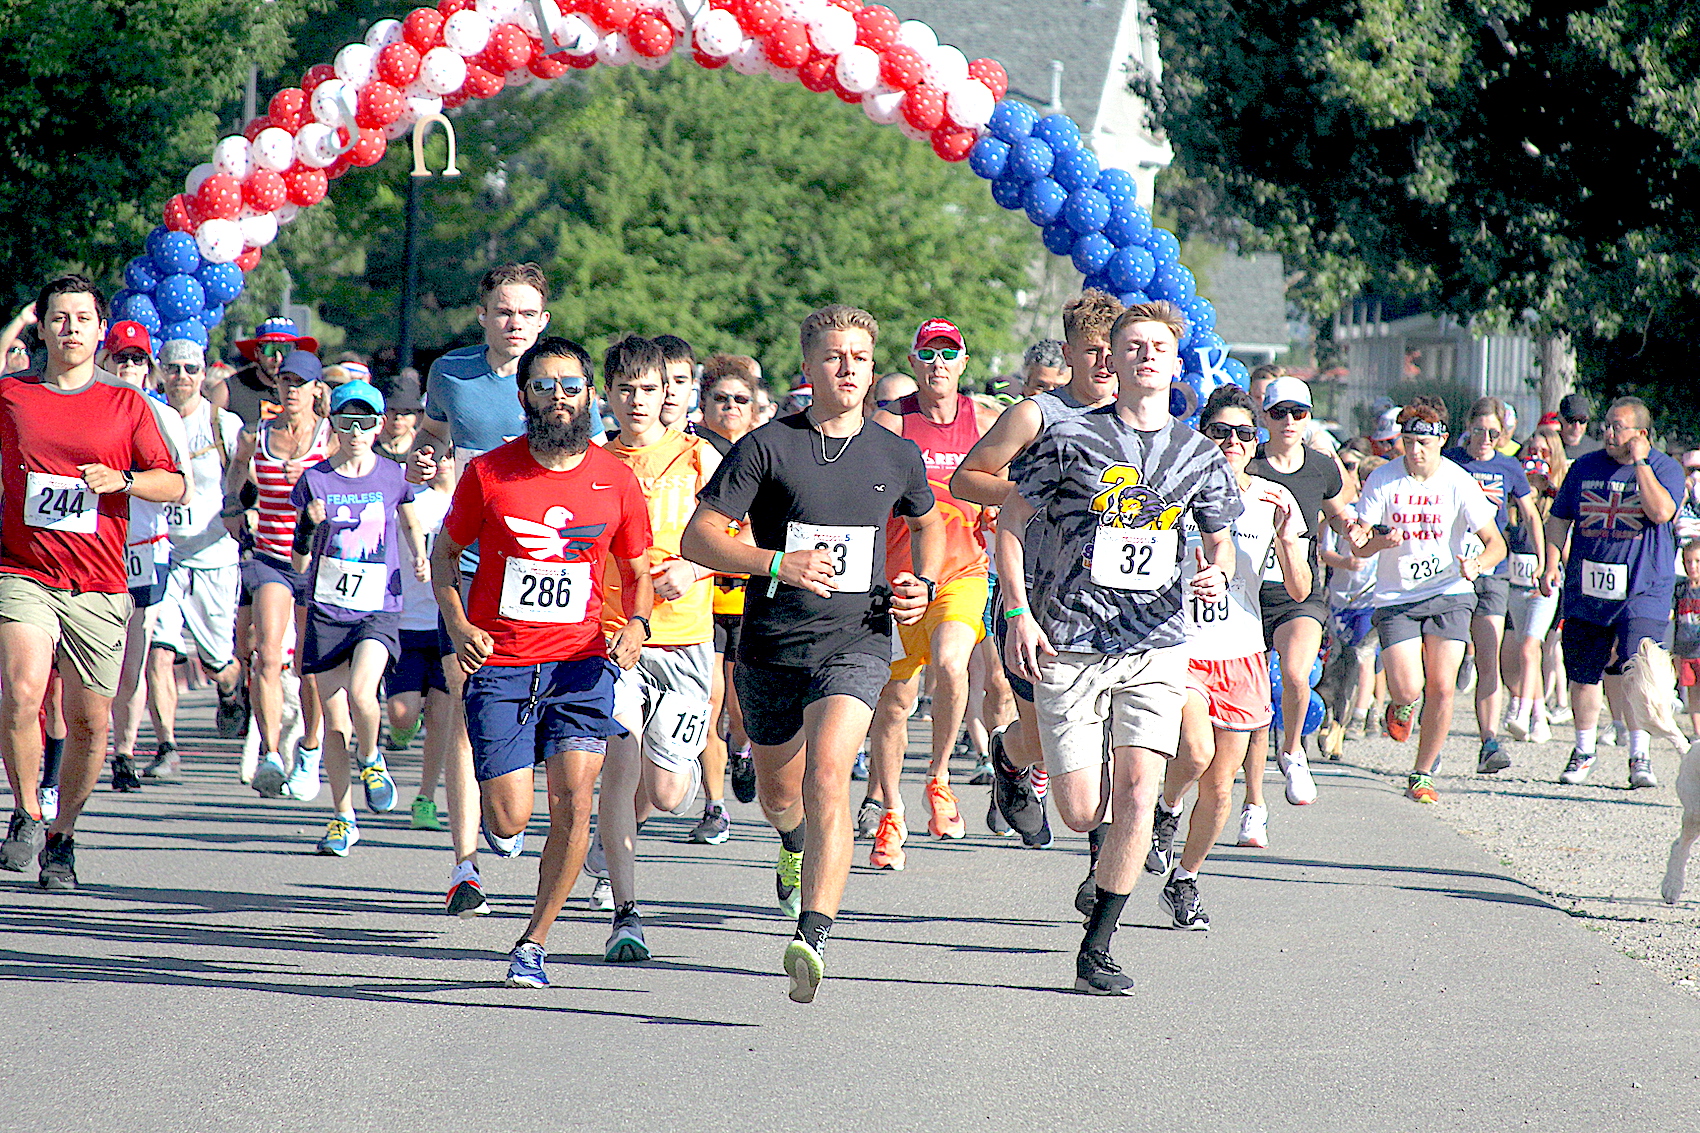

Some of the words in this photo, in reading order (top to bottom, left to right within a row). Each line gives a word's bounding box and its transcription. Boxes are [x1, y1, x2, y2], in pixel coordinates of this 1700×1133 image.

[38, 487, 84, 518] 244
[326, 491, 384, 505] FEARLESS
[1393, 493, 1399, 504] I
[1408, 495, 1444, 505] LIKE
[163, 505, 192, 525] 251
[1392, 512, 1442, 523] OLDER
[1400, 529, 1443, 540] OMEN
[814, 541, 848, 576] 3
[1119, 543, 1153, 576] 32
[1410, 557, 1443, 580] 232
[1512, 561, 1533, 578] 120
[335, 573, 363, 598] 47
[519, 574, 572, 608] 286
[1589, 570, 1615, 591] 179
[1188, 595, 1229, 623] 189
[671, 712, 706, 747] 151
